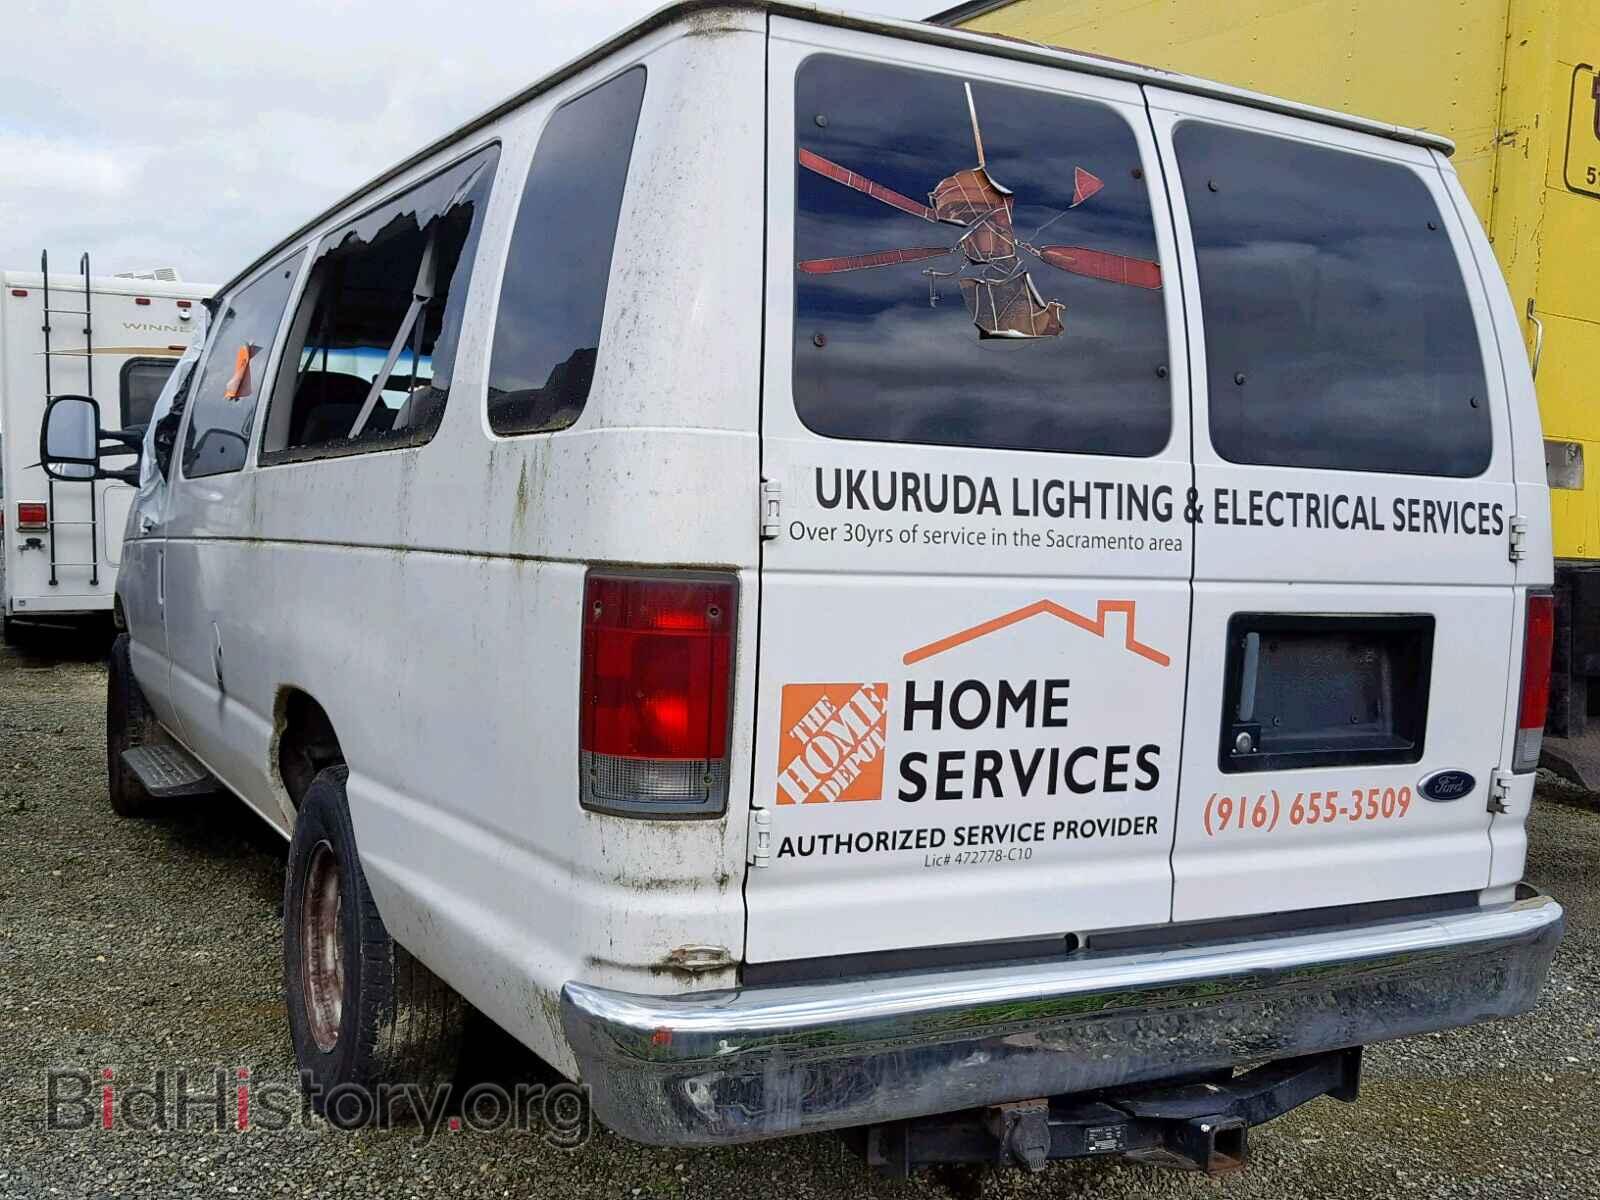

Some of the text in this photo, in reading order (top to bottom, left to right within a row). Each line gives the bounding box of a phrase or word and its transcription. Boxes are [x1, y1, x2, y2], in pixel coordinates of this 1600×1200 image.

[815, 467, 1504, 536] UKURUDA LIGHTING & ELECTRICAL SERVICES
[789, 521, 1182, 552] Over 30yrs of service in the Sacramento area
[789, 695, 838, 745] THE
[903, 679, 1070, 731] HOME
[777, 683, 888, 804] HOME
[819, 726, 886, 802] DEPOT
[898, 743, 1161, 803] SERVICES
[1434, 775, 1465, 793] Ford
[1203, 786, 1412, 836] (916) 655-3509
[777, 815, 1158, 858] AUTHORIZED SERVICE PROVIDER
[924, 847, 1033, 868] Lic# 472778-C10
